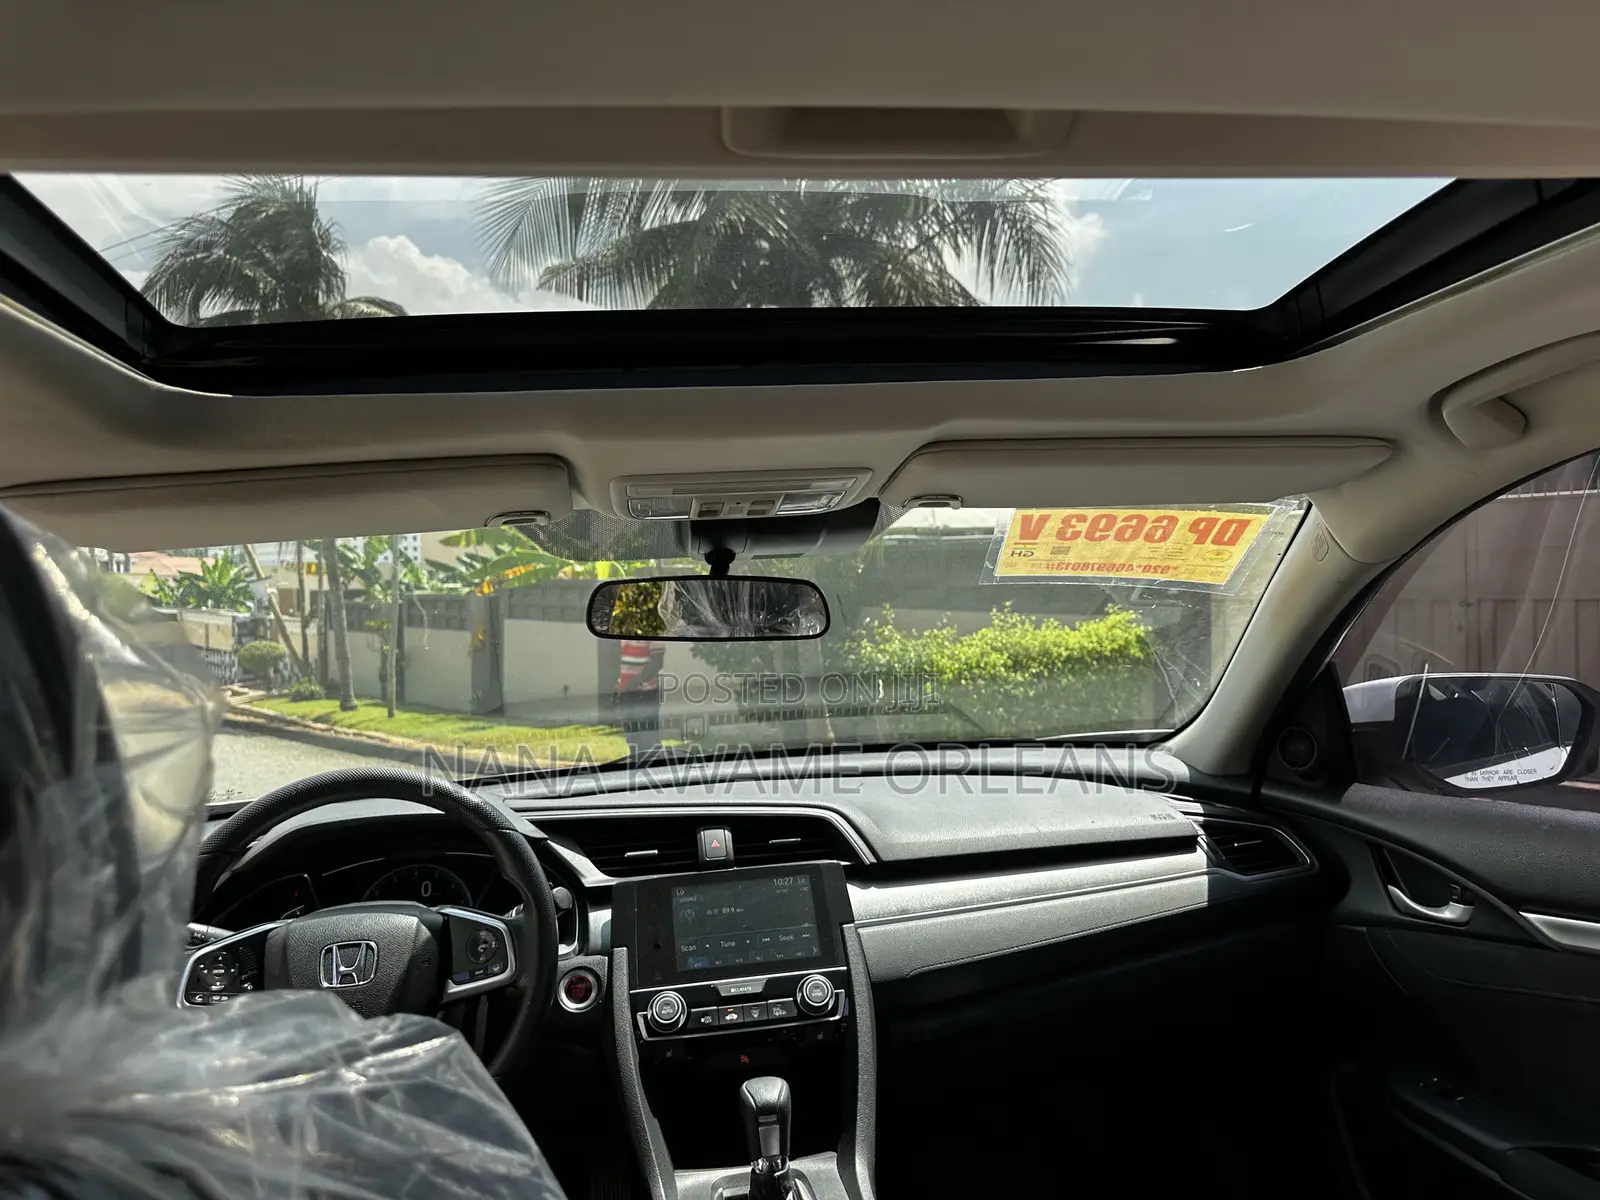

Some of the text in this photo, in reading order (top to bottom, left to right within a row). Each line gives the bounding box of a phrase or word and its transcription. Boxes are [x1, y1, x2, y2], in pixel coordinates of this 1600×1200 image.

[773, 877, 794, 886] 10:27
[420, 880, 433, 897] 0
[720, 940, 736, 948] Tune
